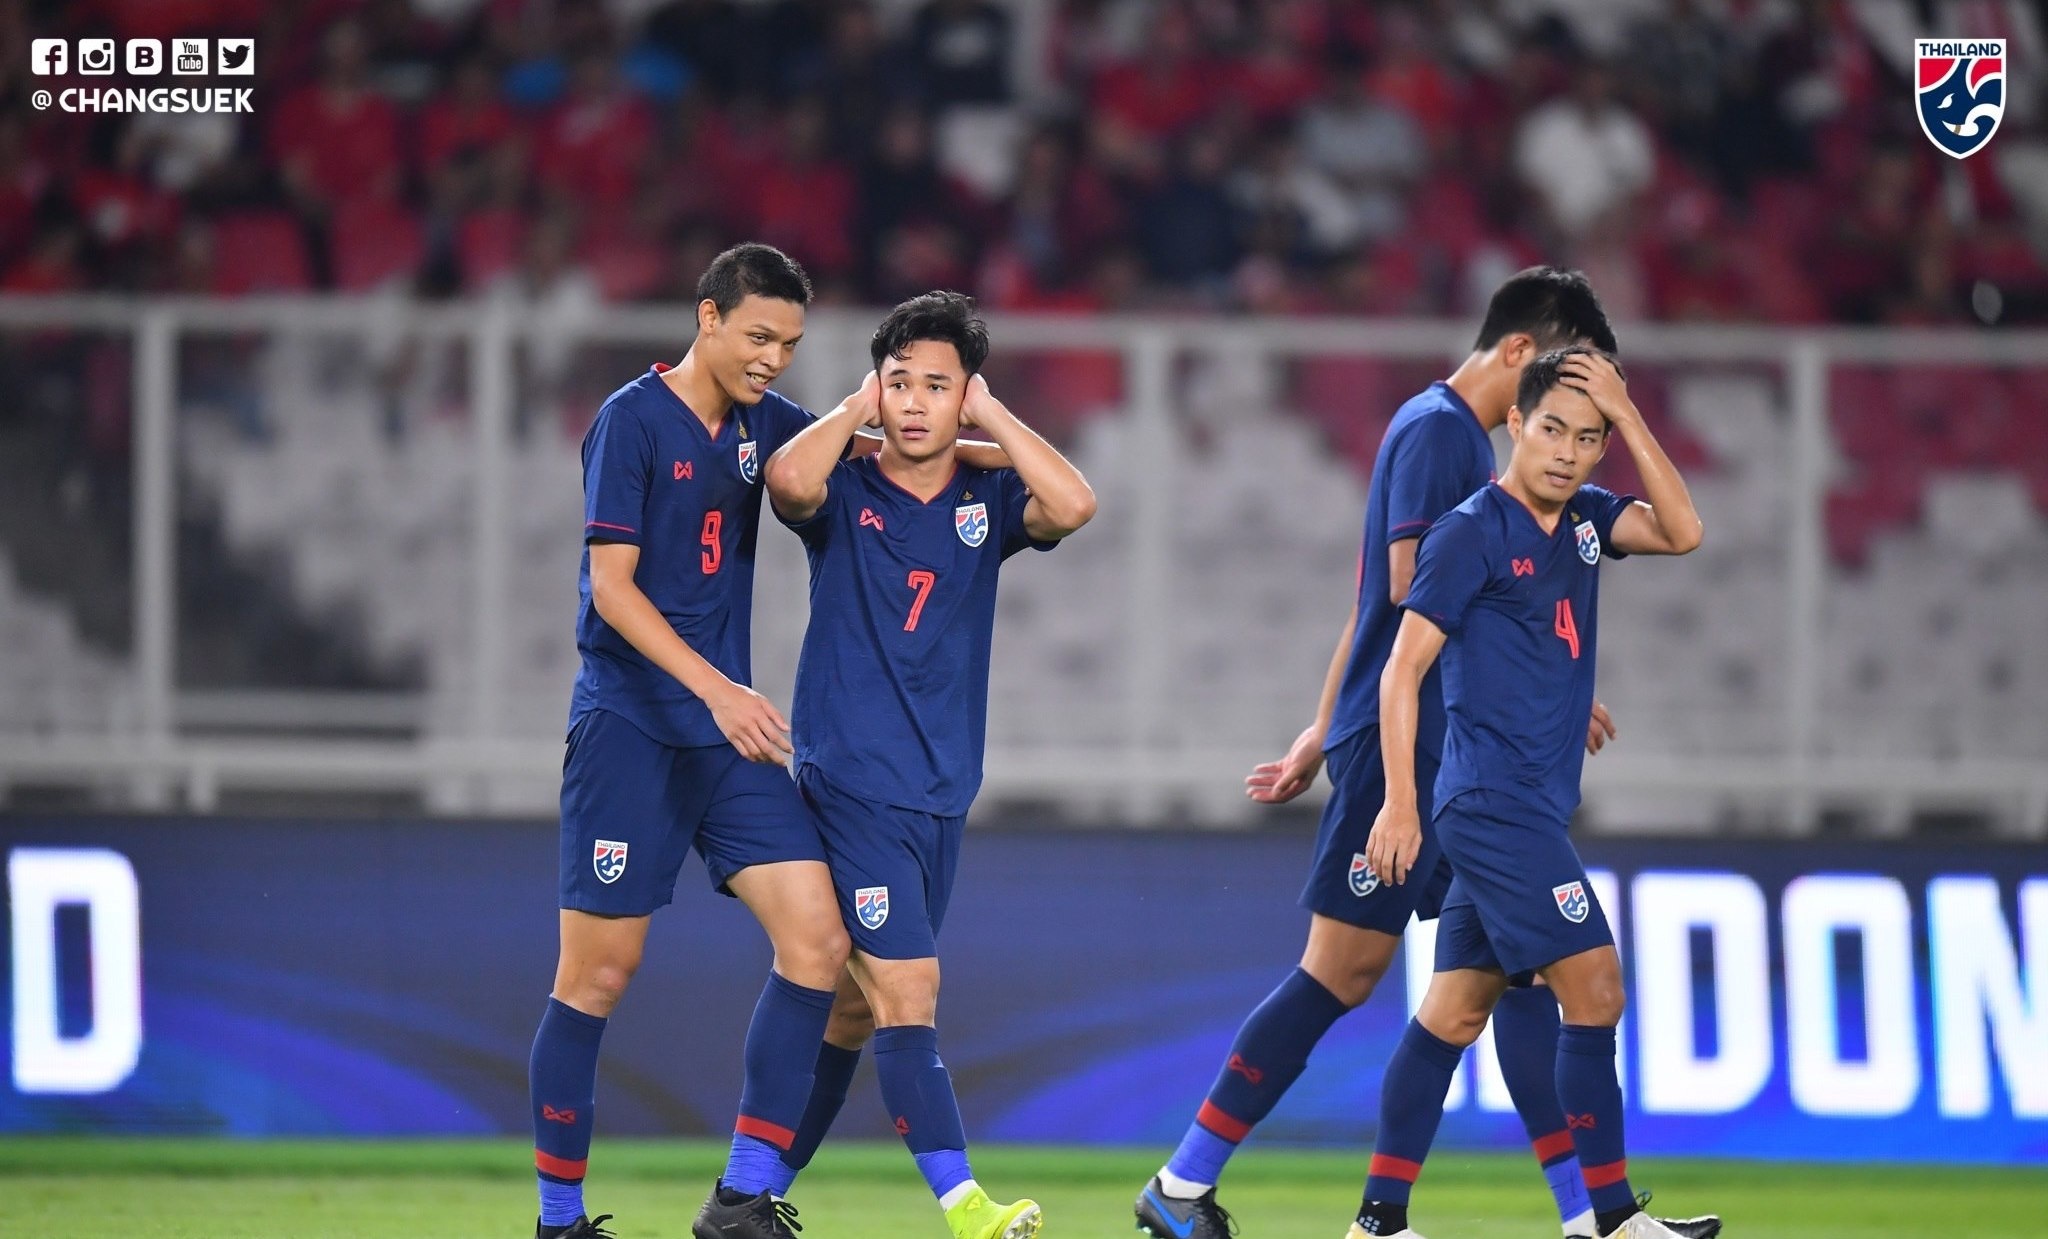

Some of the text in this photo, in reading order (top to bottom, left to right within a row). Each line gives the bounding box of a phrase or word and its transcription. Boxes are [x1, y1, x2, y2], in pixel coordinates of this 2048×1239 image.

[700, 510, 721, 575] 9
[903, 570, 935, 632] 7
[1555, 598, 1580, 659] 4
[9, 848, 143, 1095] D
